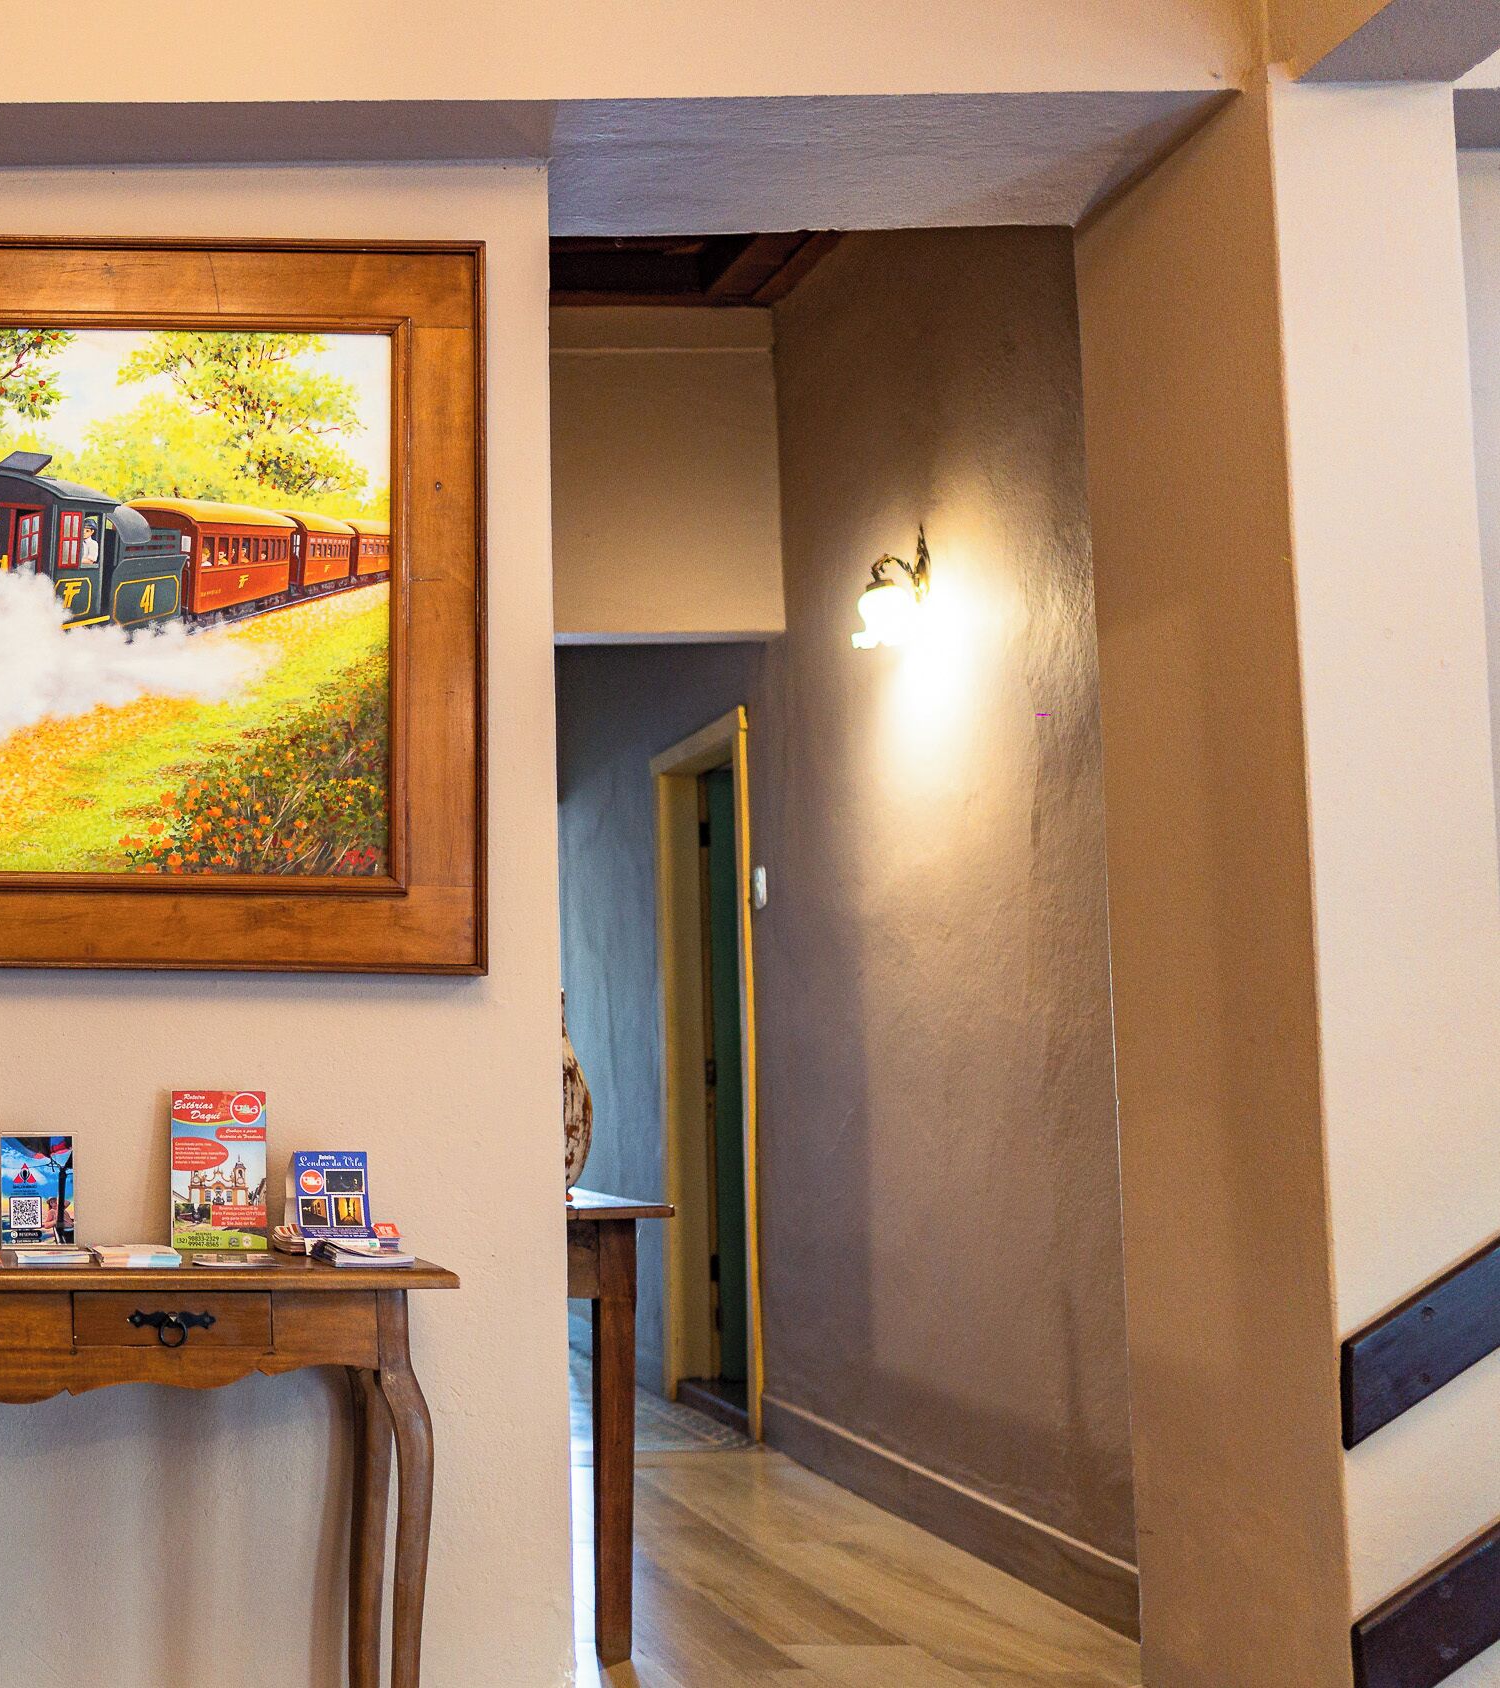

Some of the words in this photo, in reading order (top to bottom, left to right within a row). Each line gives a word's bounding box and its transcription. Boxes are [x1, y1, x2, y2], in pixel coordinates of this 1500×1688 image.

[139, 583, 156, 614] 41
[173, 1099, 213, 1110] Estórias
[298, 1155, 330, 1167] Lendas
[331, 1159, 342, 1167] da
[343, 1155, 363, 1167] Vila
